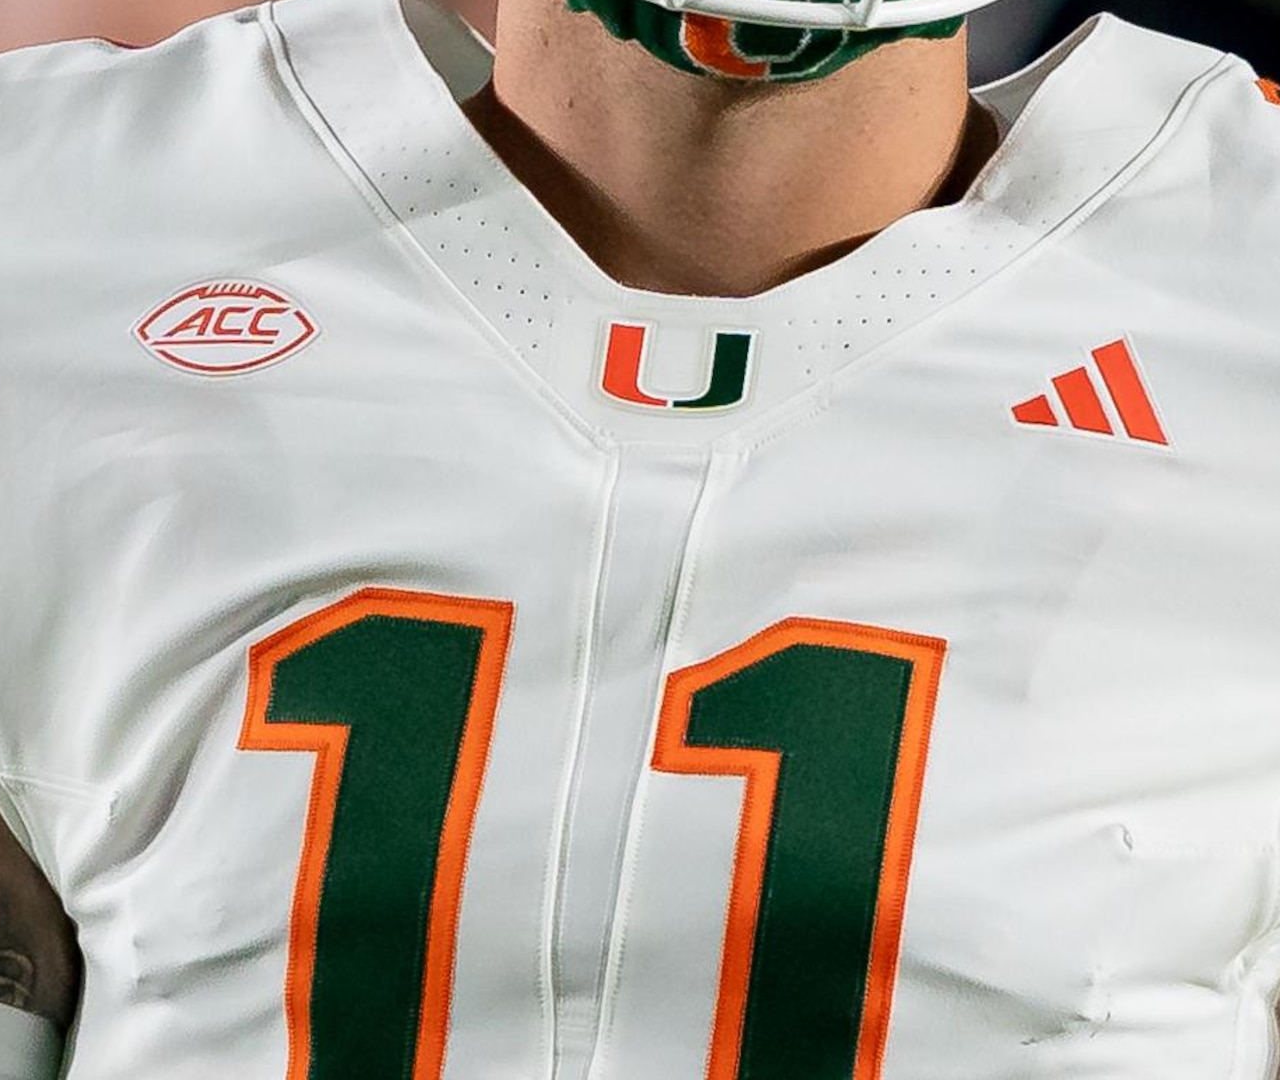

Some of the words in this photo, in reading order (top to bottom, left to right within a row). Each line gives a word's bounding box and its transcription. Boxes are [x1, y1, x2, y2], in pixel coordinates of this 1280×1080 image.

[164, 306, 291, 338] ACC
[602, 322, 752, 409] U
[237, 587, 948, 1080] 11
